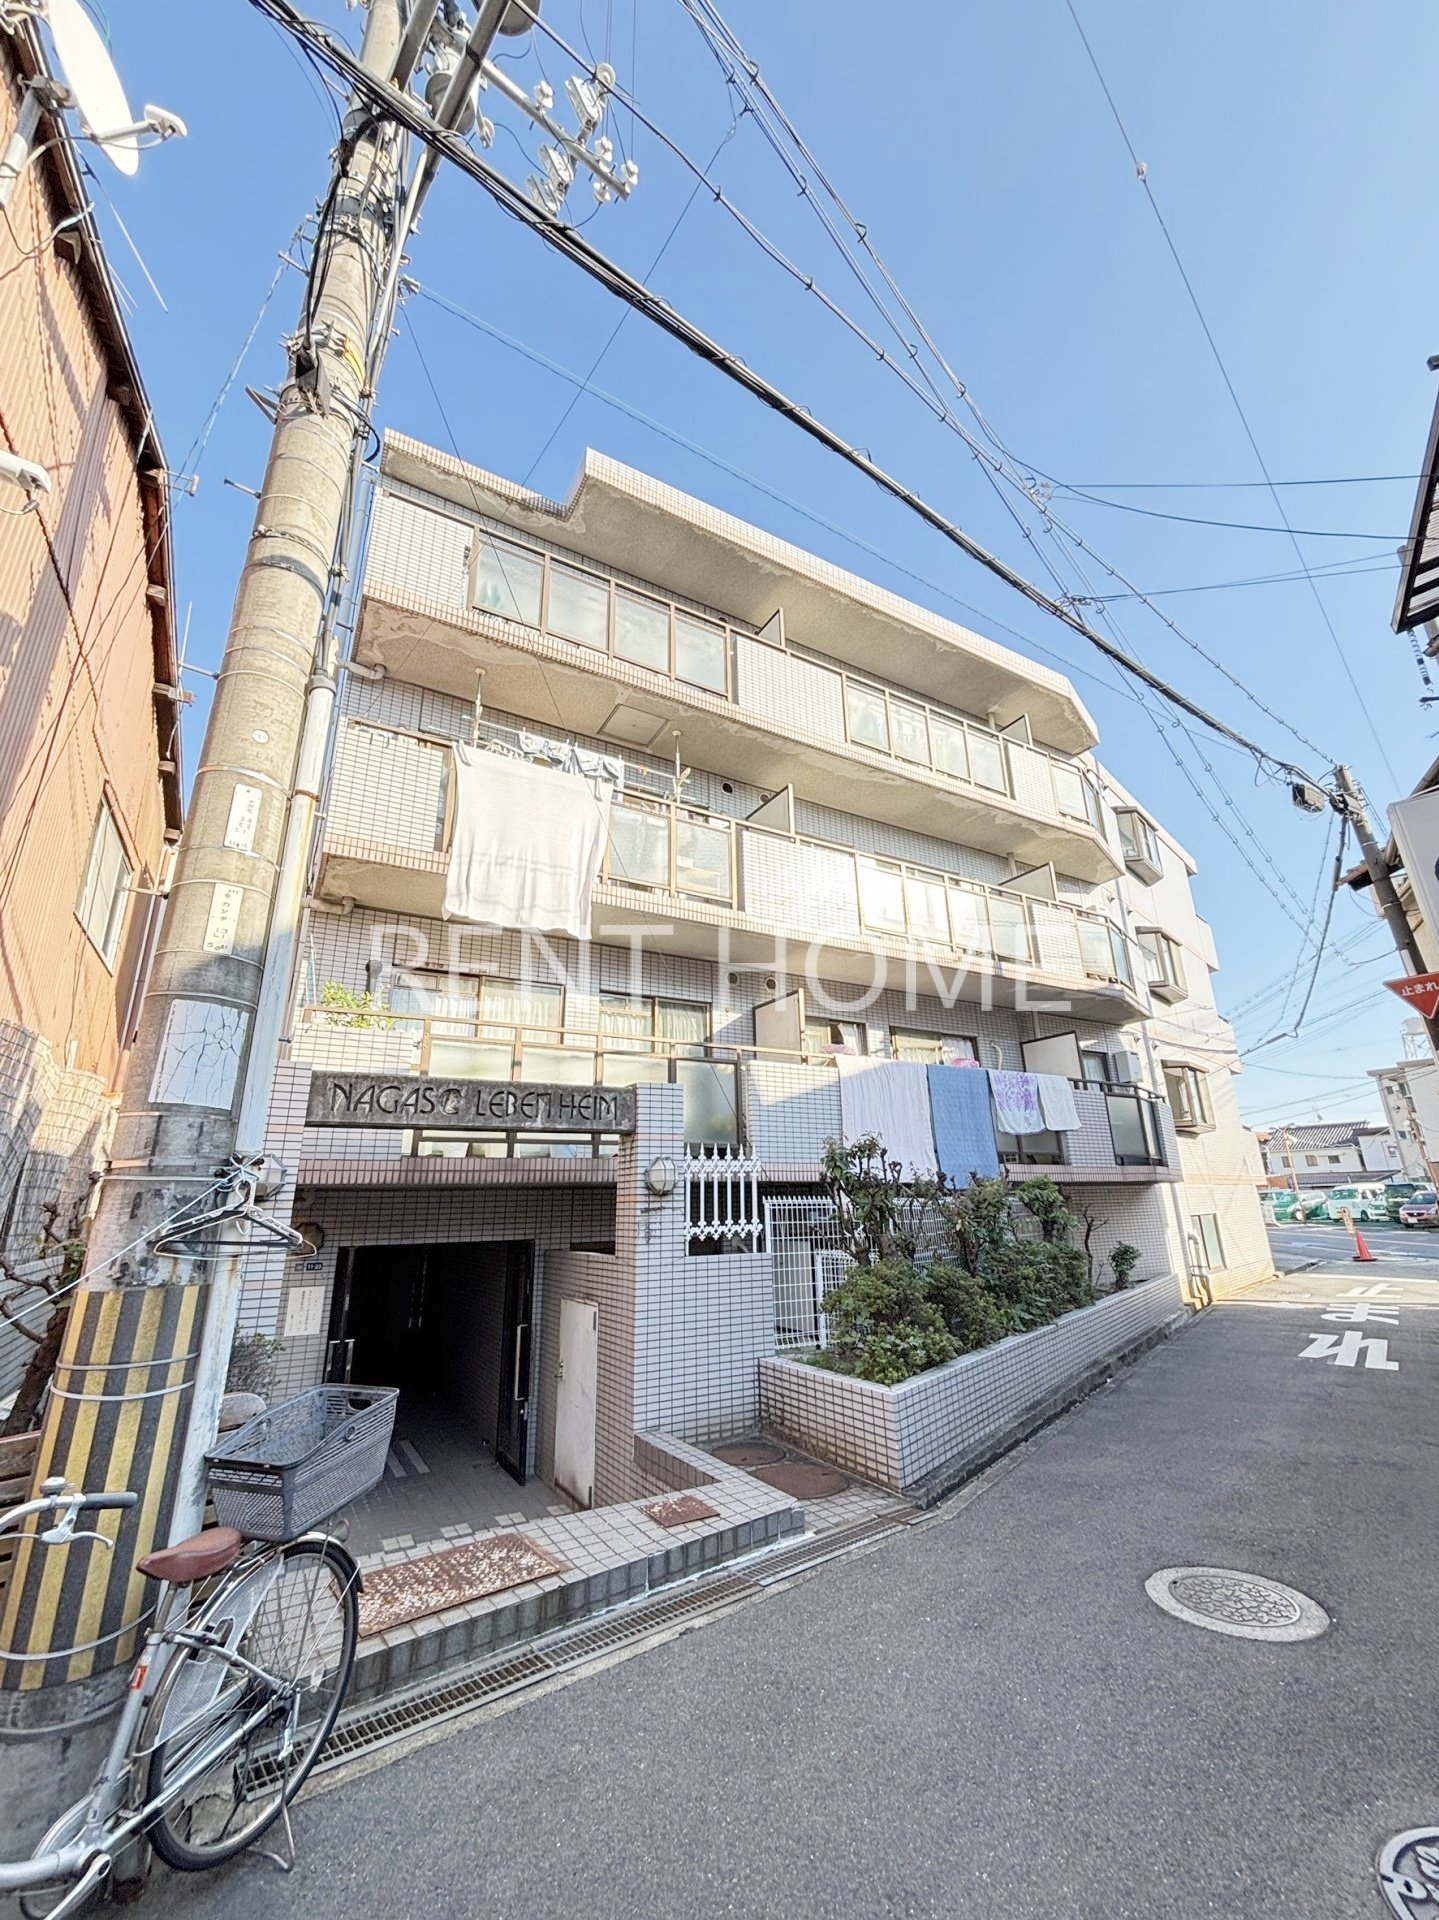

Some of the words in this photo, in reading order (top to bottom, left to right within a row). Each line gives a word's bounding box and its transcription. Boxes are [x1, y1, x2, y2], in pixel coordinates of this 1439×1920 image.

[1402, 981, 1439, 996] 止まれ
[476, 1090, 553, 1119] LEBEN
[559, 1094, 618, 1121] HEIM
[1298, 1282, 1404, 1371] 止まれ
